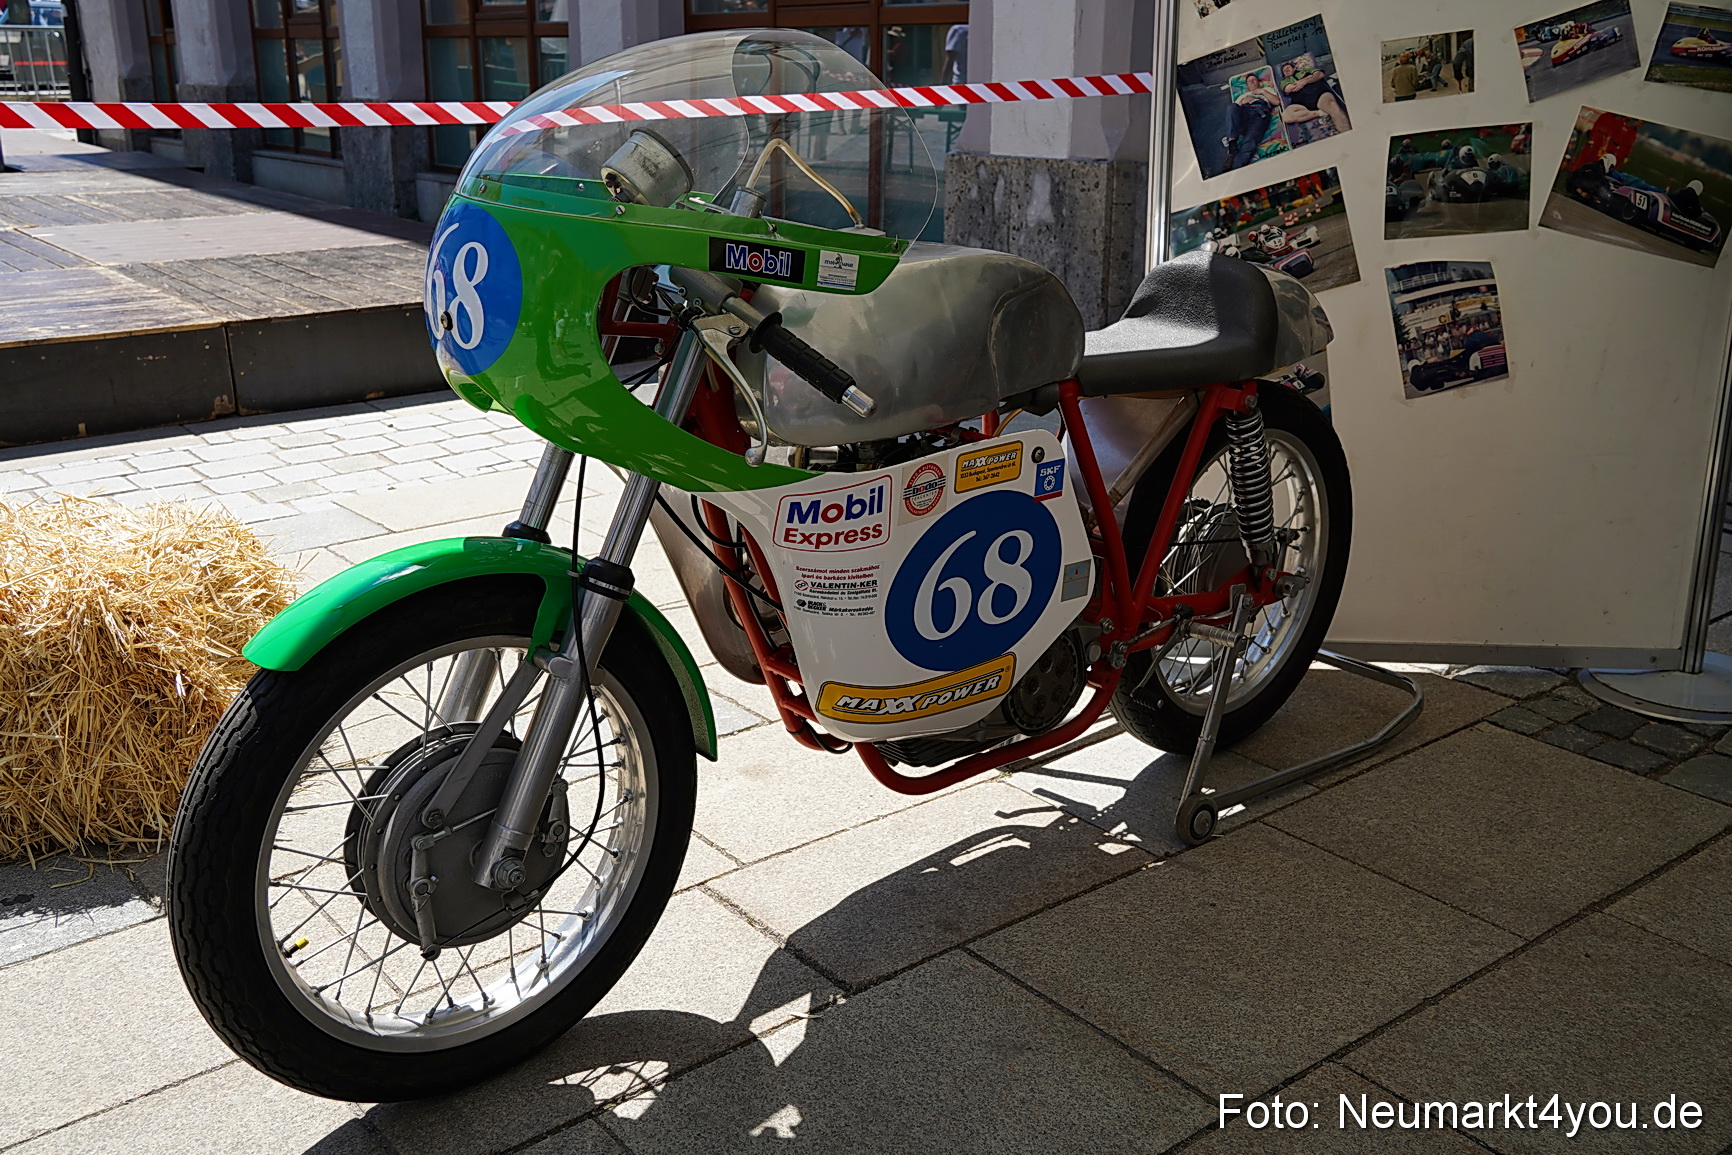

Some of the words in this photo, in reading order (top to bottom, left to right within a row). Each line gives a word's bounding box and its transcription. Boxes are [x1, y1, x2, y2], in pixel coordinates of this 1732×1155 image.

[1637, 195, 1647, 208] 51
[726, 243, 792, 277] Mobil
[427, 222, 489, 350] 68
[987, 452, 1017, 465] POWER
[1040, 465, 1062, 477] SKF
[787, 485, 884, 525] Mobil
[783, 523, 883, 549] Express
[795, 565, 828, 574] Szerszámot
[810, 579, 878, 589] VALENTIN-KER
[914, 529, 1034, 641] 68
[836, 692, 922, 716] MAXX
[919, 675, 1002, 710] POWER
